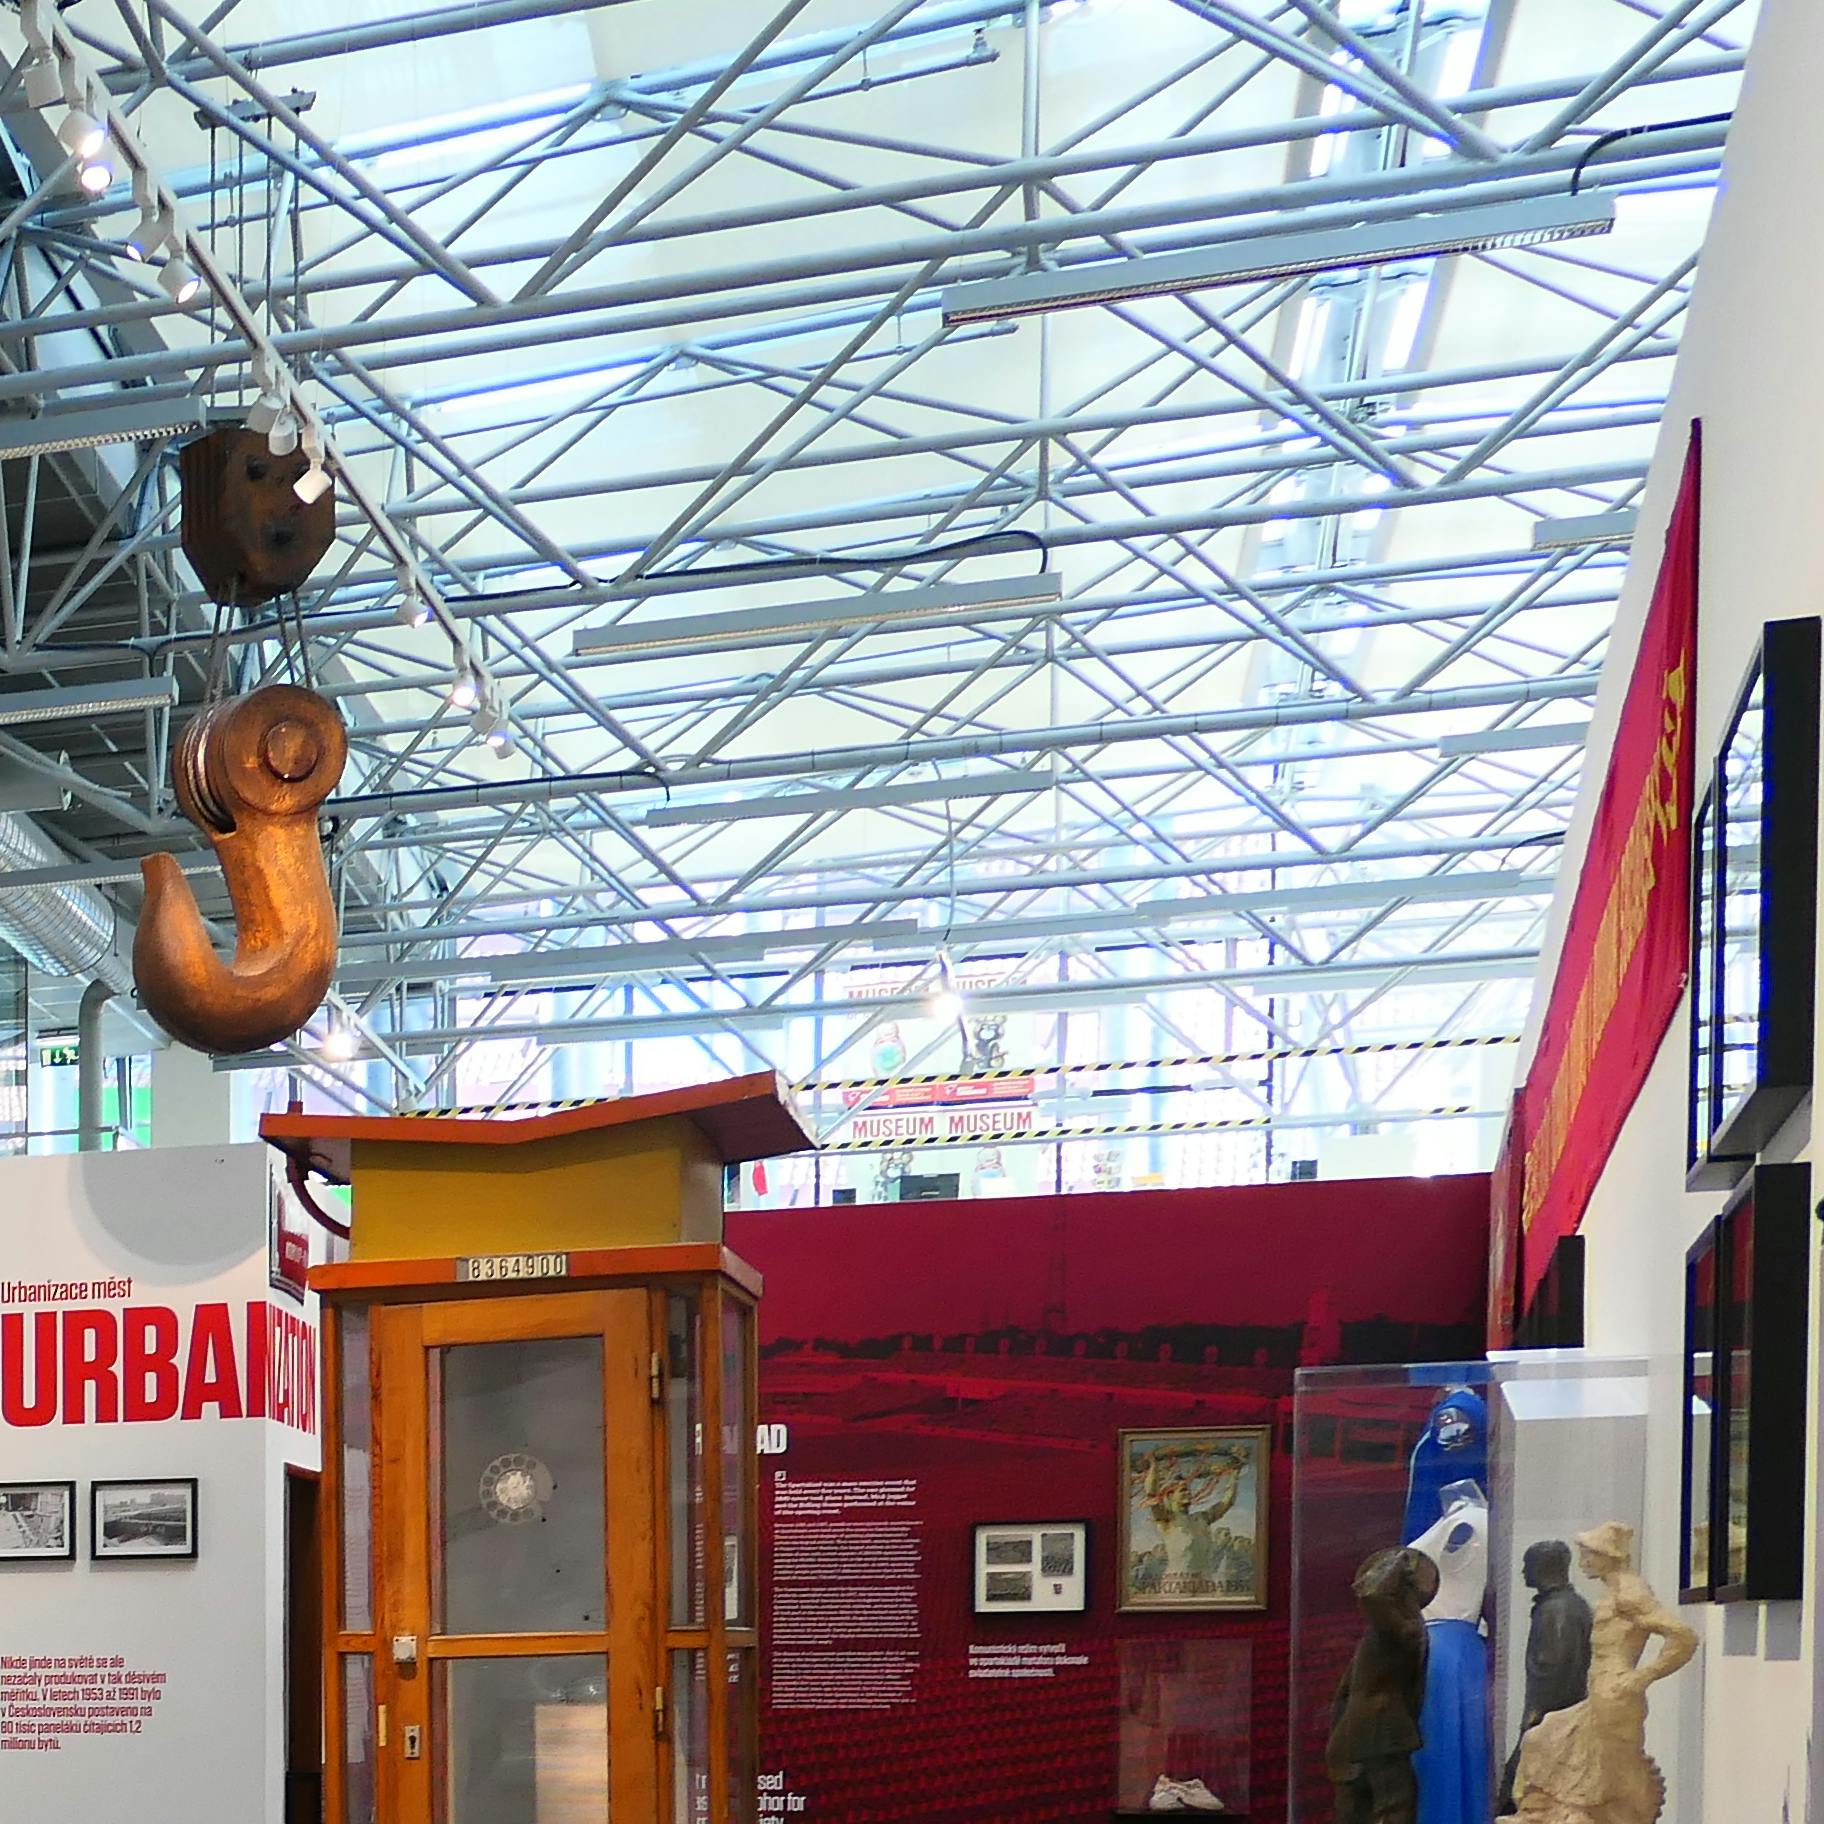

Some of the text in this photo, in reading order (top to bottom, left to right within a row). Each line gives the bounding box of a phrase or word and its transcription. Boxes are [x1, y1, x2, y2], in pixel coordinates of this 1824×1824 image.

[852, 1117, 934, 1138] MUSEUM
[949, 1112, 1032, 1133] MUSEUM
[471, 1256, 563, 1279] 8364900
[1, 1276, 133, 1304] Urbanizace měst
[757, 1770, 783, 1789] sed
[786, 1792, 806, 1811] for
